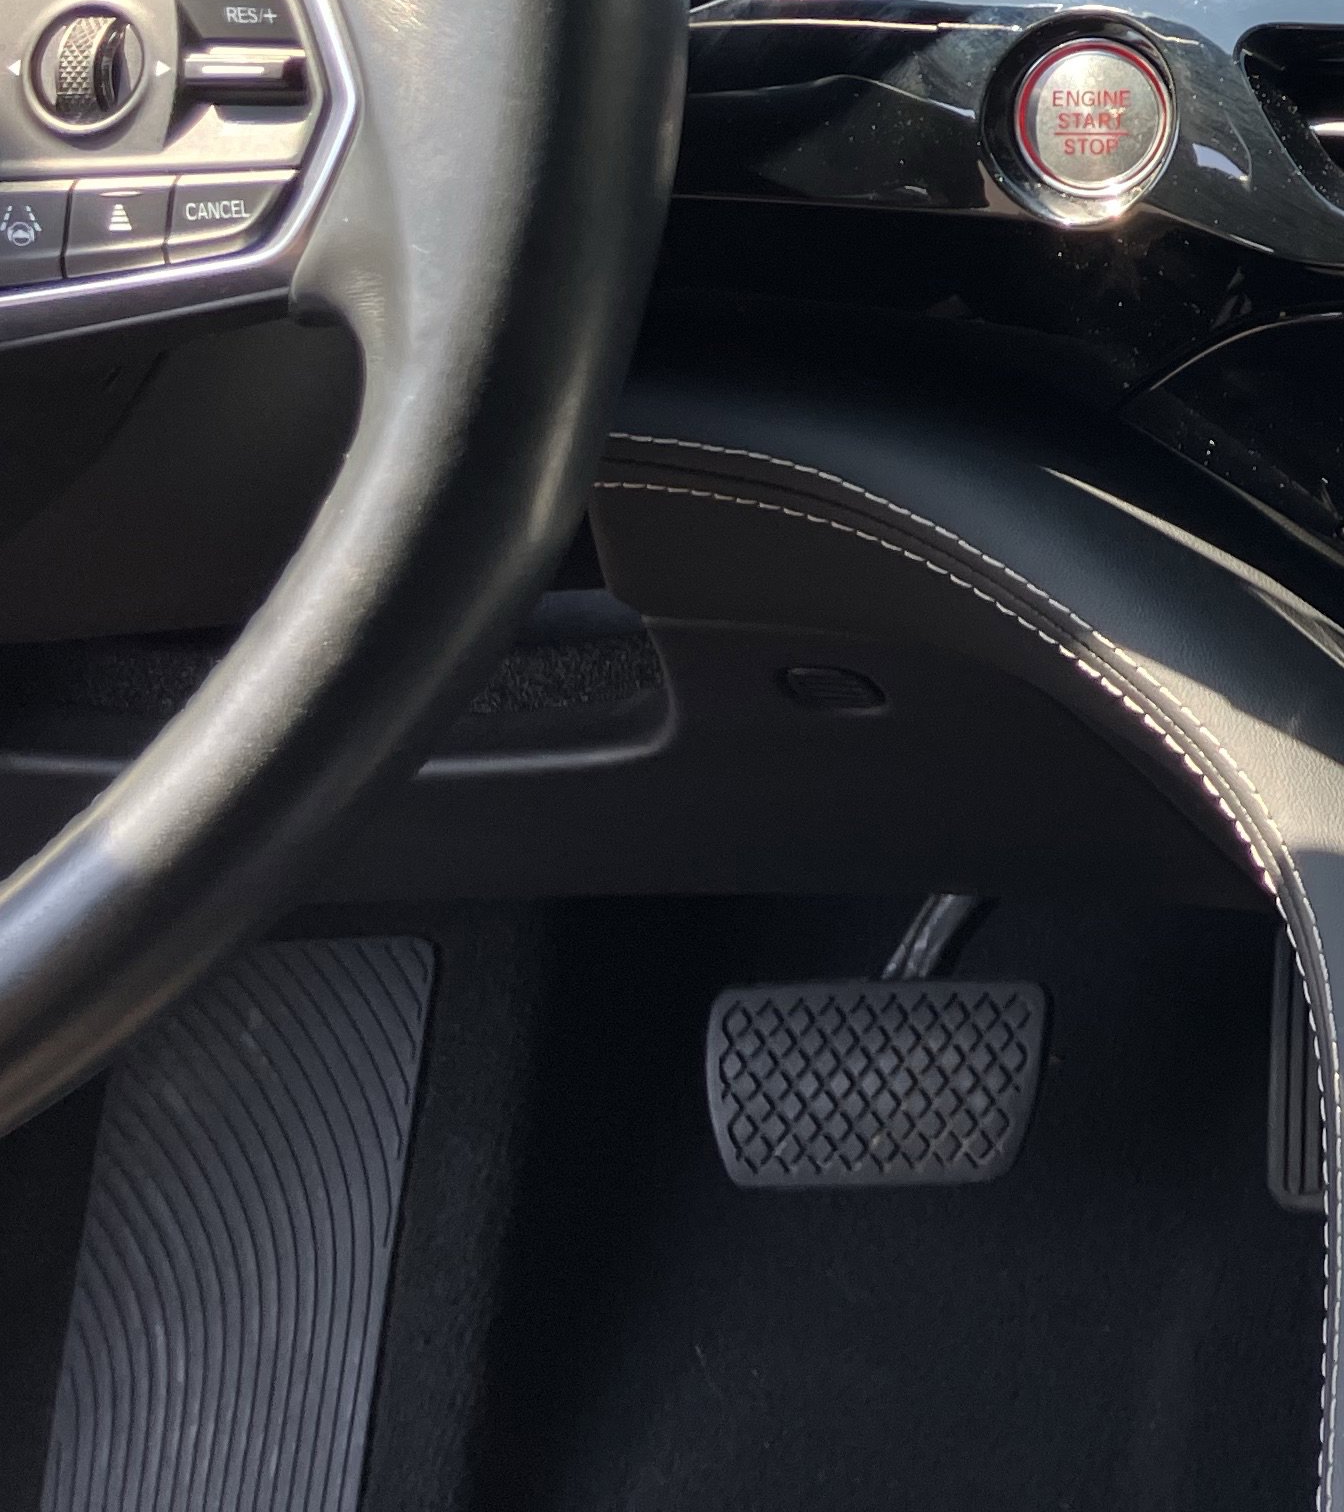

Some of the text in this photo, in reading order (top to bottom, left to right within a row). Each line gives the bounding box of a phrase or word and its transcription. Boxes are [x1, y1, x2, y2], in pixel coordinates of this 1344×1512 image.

[1052, 90, 1131, 107] ENGINE
[1058, 113, 1122, 129] START
[1064, 139, 1119, 155] STOP
[185, 199, 251, 221] CANCEL
